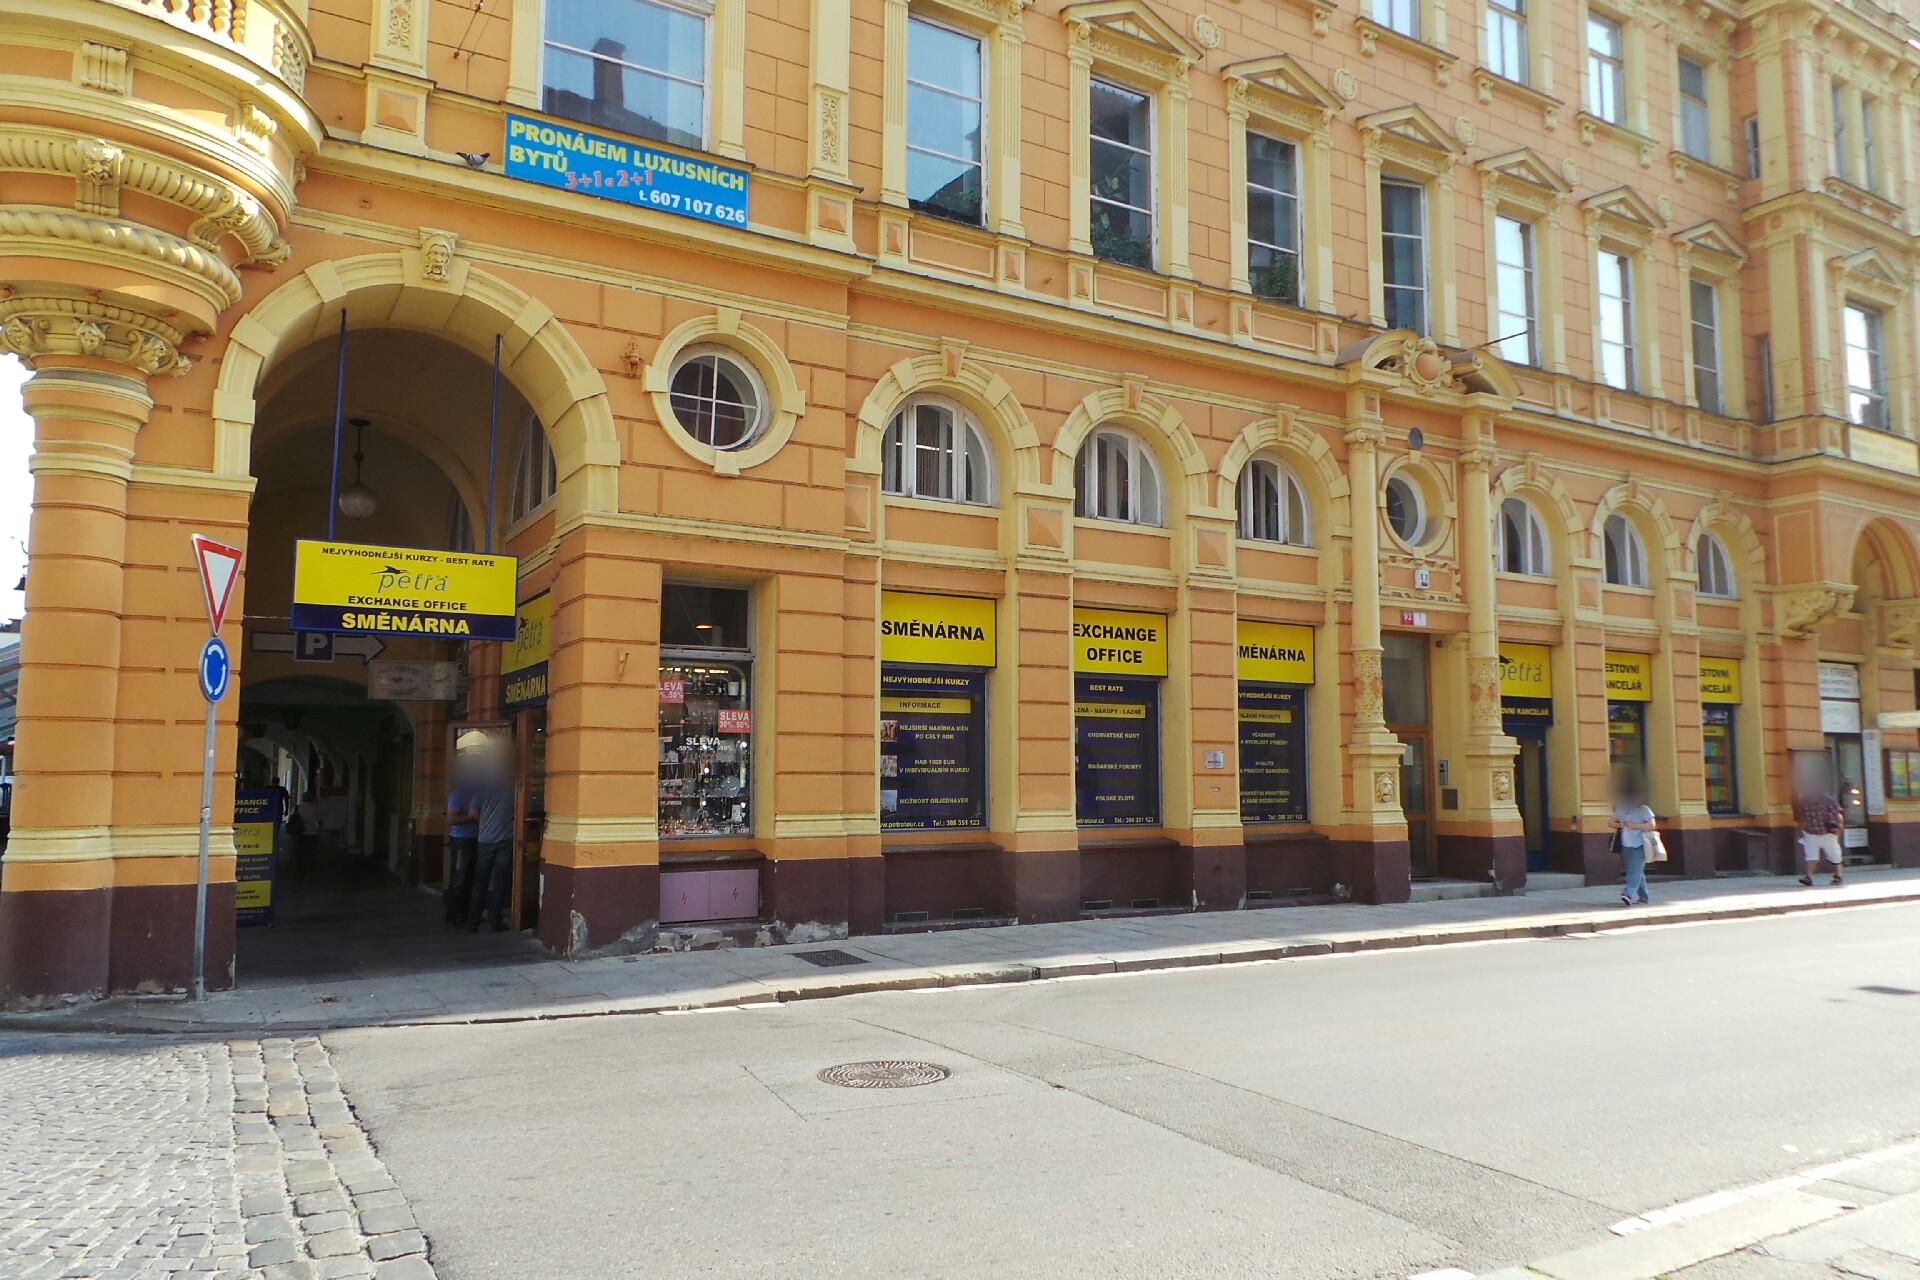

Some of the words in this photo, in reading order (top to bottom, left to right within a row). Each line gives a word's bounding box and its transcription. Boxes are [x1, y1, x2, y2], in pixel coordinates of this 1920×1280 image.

[509, 145, 568, 174] BYTŮ
[510, 120, 627, 162] PRONÁJEM
[633, 150, 744, 192] LUXUSNÍCH
[565, 171, 601, 190] 3+1
[616, 168, 654, 187] 2+1
[650, 190, 680, 208] 607
[684, 197, 712, 216] 107
[714, 205, 745, 223] 626
[322, 548, 403, 560] NEJVÝHODNĚJŠÍ
[406, 554, 438, 563] KURZY
[446, 557, 470, 565] BEST
[472, 558, 495, 567] RATE
[348, 596, 419, 608] EXCHANGE
[424, 600, 467, 610] OFFICE
[342, 612, 470, 634] SMĚNÁRNA
[881, 619, 985, 641] SMĚNÁRNA
[1073, 624, 1156, 642] EXCHANGE
[304, 634, 328, 654] P
[1237, 644, 1305, 662] MĚNÁRNA
[1086, 648, 1142, 664] OFFICE
[506, 674, 546, 704] SMĚNÁRNA
[720, 711, 749, 720] SLEVA
[686, 737, 720, 746] SLEVA
